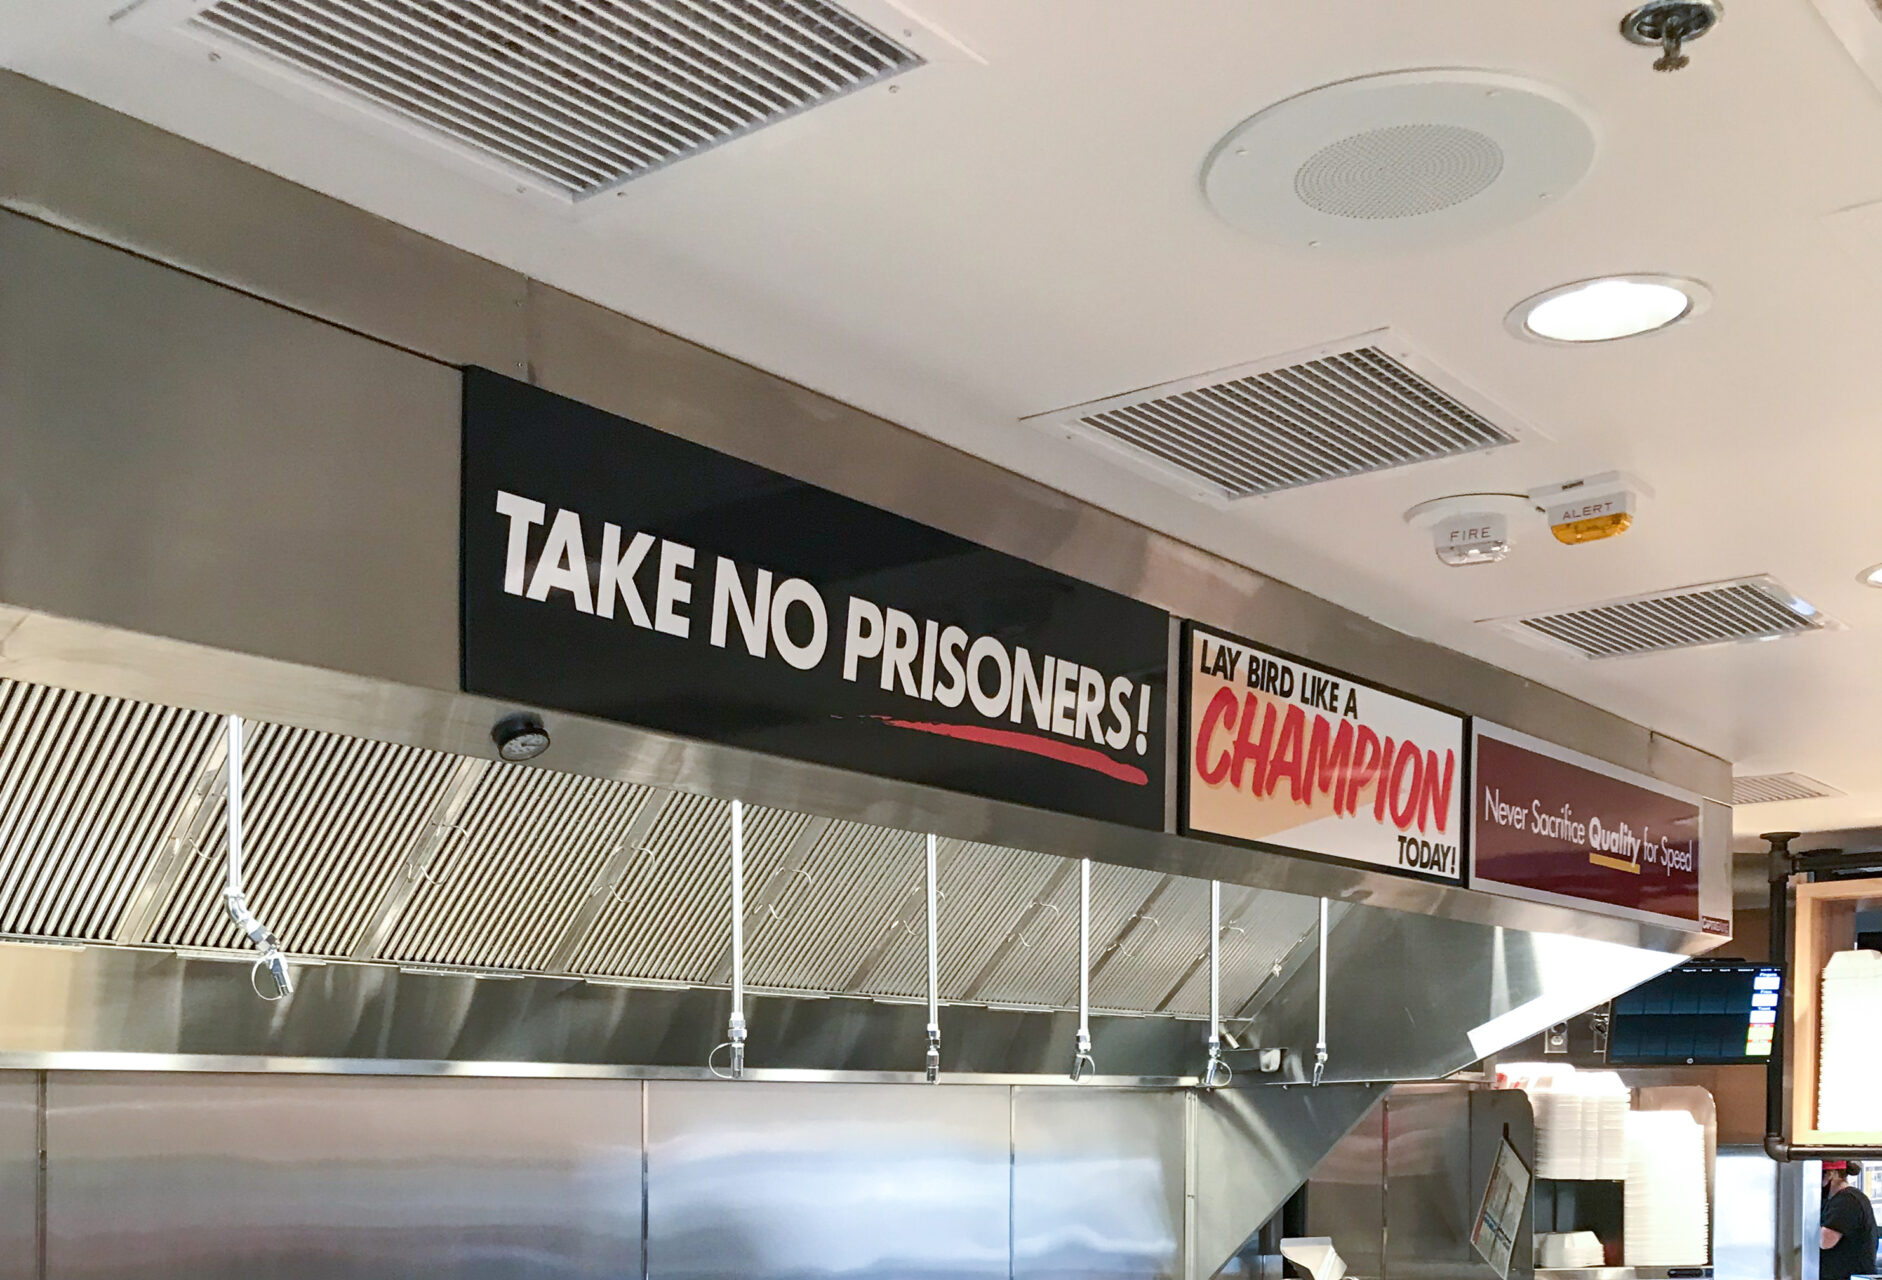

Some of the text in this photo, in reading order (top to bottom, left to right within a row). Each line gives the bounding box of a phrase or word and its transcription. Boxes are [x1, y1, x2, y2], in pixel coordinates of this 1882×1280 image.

[1450, 527, 1491, 542] FIRE
[1562, 502, 1613, 520] ALERT
[496, 489, 1151, 755] TAKE NO PRISONERS!
[1201, 639, 1358, 719] LAY BIRD LIKE A
[1196, 686, 1455, 833] CHAMPION
[1398, 836, 1456, 875] TODAY!
[1485, 786, 1692, 876] Never Sacrifice Quality for Speed
